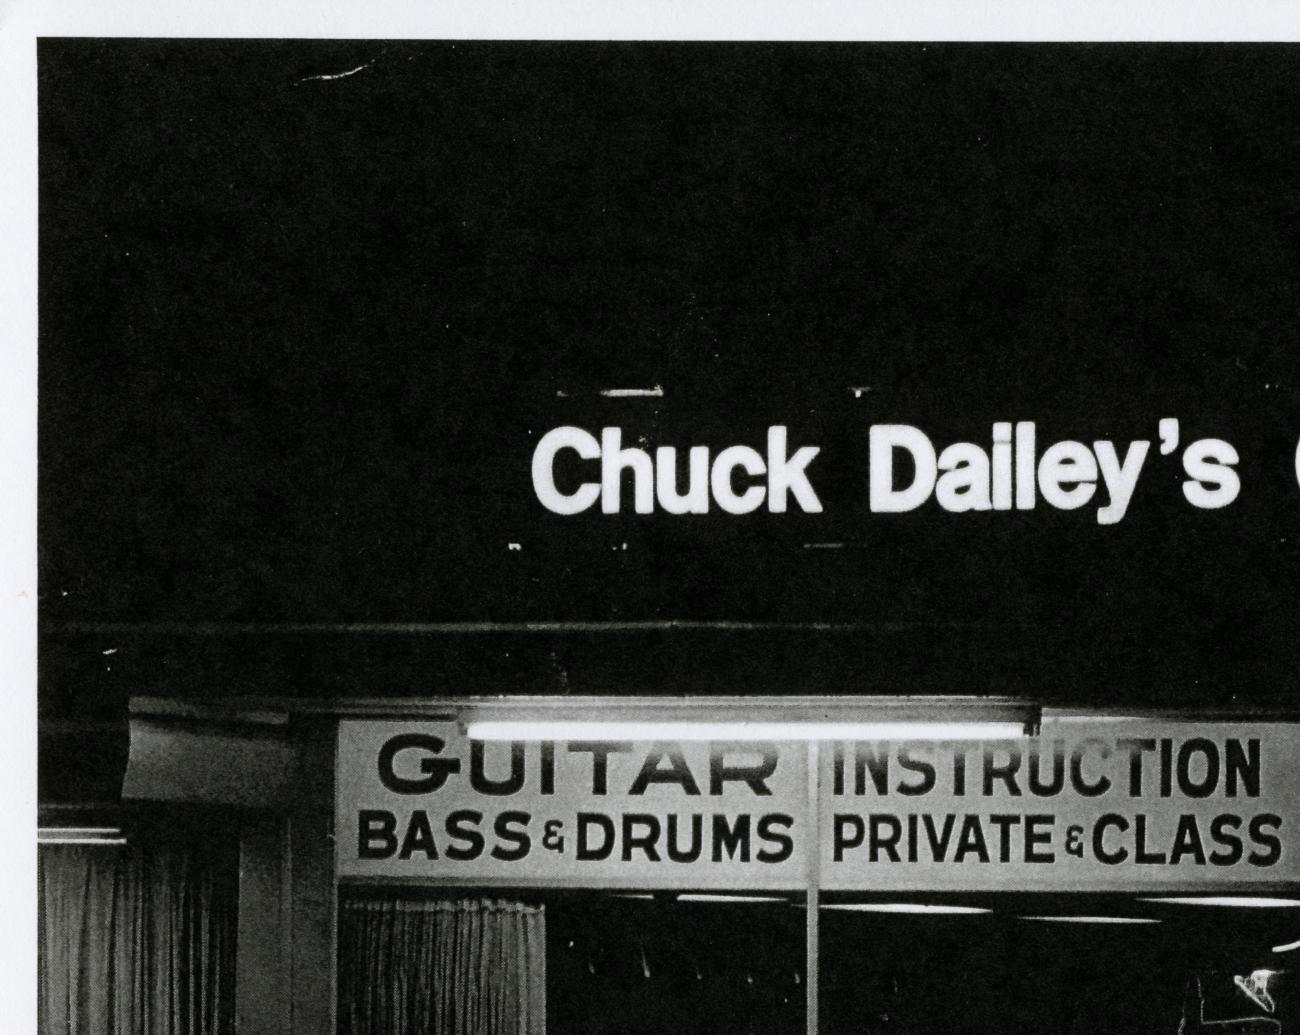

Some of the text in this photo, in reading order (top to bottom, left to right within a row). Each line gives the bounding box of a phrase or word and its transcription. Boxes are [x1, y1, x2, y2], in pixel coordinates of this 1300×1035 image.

[531, 425, 824, 515] Chuck
[869, 418, 1241, 525] Dailey's
[377, 733, 779, 797] GUITAR
[833, 738, 1262, 798] INSTRUCTION
[357, 809, 795, 864] BASS & DRUMS
[833, 813, 1283, 867] PRIVATE & CLASS
